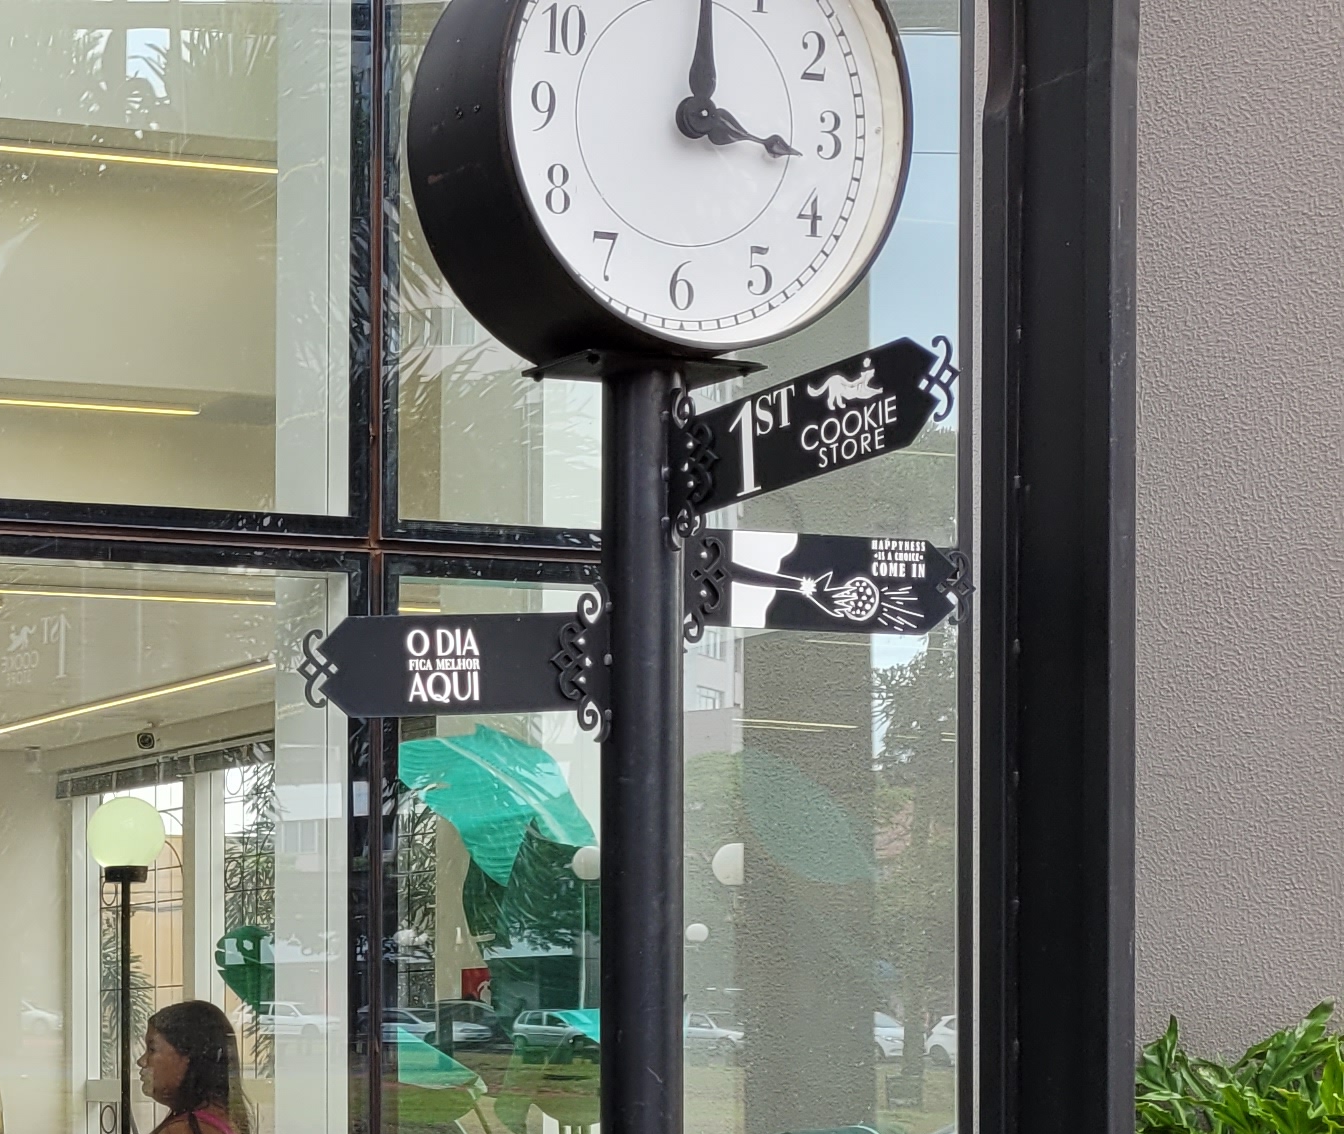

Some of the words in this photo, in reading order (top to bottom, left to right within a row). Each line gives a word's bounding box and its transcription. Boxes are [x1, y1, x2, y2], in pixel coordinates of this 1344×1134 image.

[542, 3, 586, 56] 10
[800, 31, 826, 82] 2
[531, 80, 556, 132] 9
[817, 110, 842, 160] 3
[545, 163, 571, 215] 8
[797, 187, 823, 239] 4
[593, 231, 619, 282] 7
[747, 246, 773, 296] 5
[669, 261, 694, 311] 6
[801, 395, 897, 450] COOKIE
[818, 428, 885, 468] STORE
[871, 539, 926, 552] HAPPYNESS
[872, 562, 906, 577] COME
[911, 563, 925, 578] IN
[878, 551, 885, 560] IS
[887, 552, 892, 560] A
[894, 552, 920, 561] CHOICE
[406, 629, 430, 657] O
[436, 628, 480, 657] DIA
[408, 658, 433, 671] FICA
[436, 658, 480, 670] MELHOR
[408, 671, 480, 703] AQUI
